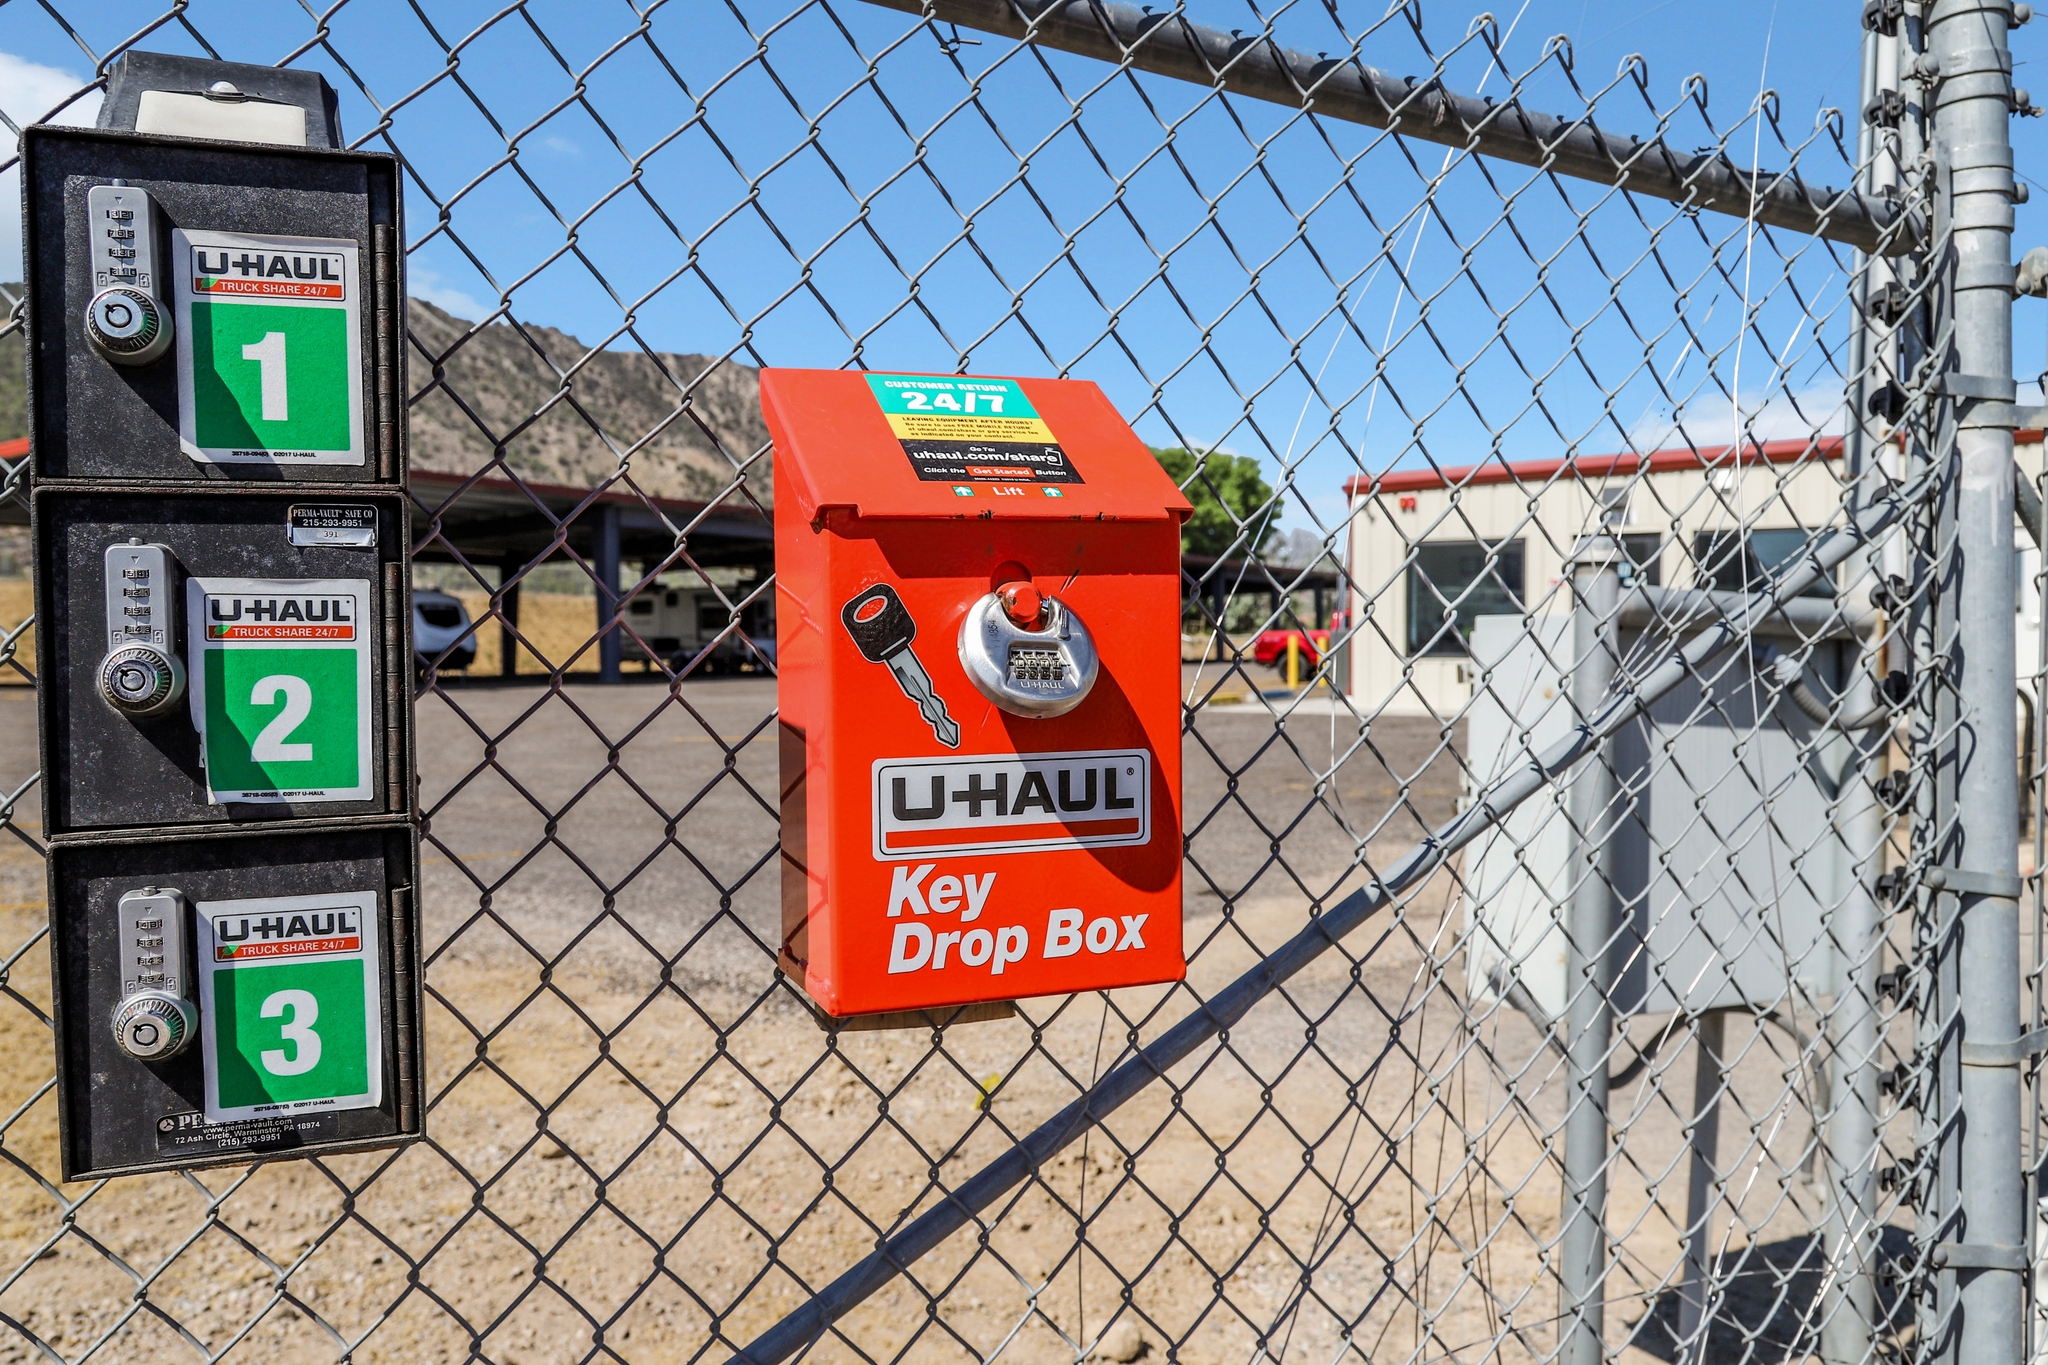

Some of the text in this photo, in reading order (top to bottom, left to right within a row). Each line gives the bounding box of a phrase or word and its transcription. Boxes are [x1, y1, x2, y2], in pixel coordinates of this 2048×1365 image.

[197, 251, 340, 280] U-HAUL
[220, 281, 328, 296] TRUCK SHARE 24/7
[242, 331, 288, 421] 1
[884, 380, 1008, 392] CUSTOMER RETURN
[901, 391, 1004, 413] 24/7
[913, 451, 1058, 462] uhaul.com/share
[992, 486, 1026, 496] Lift
[303, 519, 363, 527] 215-293-9951
[345, 510, 362, 518] SAFE
[363, 510, 373, 518] CO
[211, 599, 351, 622] U-HAUL
[233, 627, 339, 637] TRUCK SHARE 24/7
[250, 674, 313, 762] 2
[886, 863, 997, 922] Key
[219, 912, 357, 942] U-HAUL
[241, 940, 345, 956] TRUCK SHARE 24/7
[887, 907, 1150, 976] Drop Box
[260, 989, 322, 1076] 3
[175, 1121, 320, 1144] 72 Ash Circle, Warminster, PA 18974
[203, 1118, 293, 1134] www.perma-vault.com
[217, 1133, 281, 1148] (215) 293-9951
